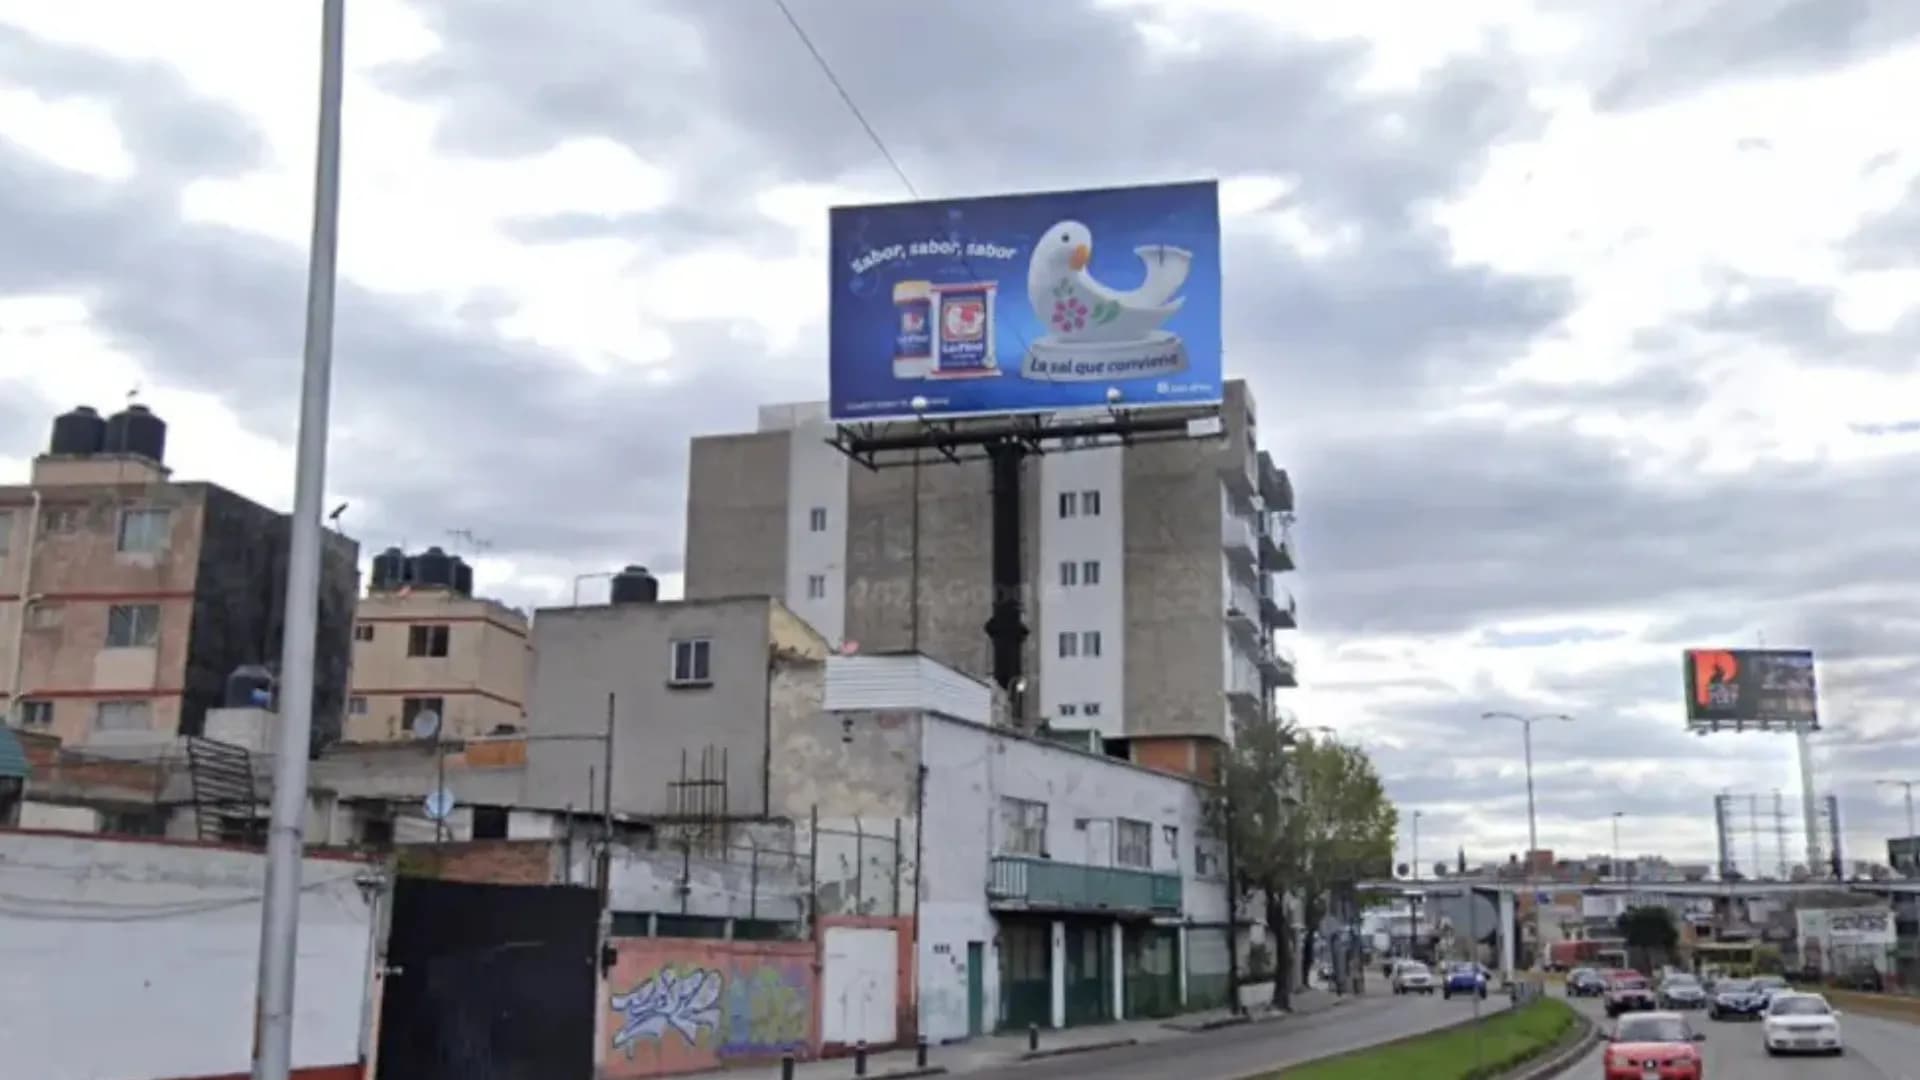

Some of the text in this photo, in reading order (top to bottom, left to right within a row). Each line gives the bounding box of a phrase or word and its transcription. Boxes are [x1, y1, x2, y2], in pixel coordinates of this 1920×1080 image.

[909, 239, 963, 257] sabor,
[966, 241, 1018, 259] sabor
[1030, 356, 1047, 373] La
[1050, 358, 1073, 374] sal
[1075, 360, 1105, 375] que
